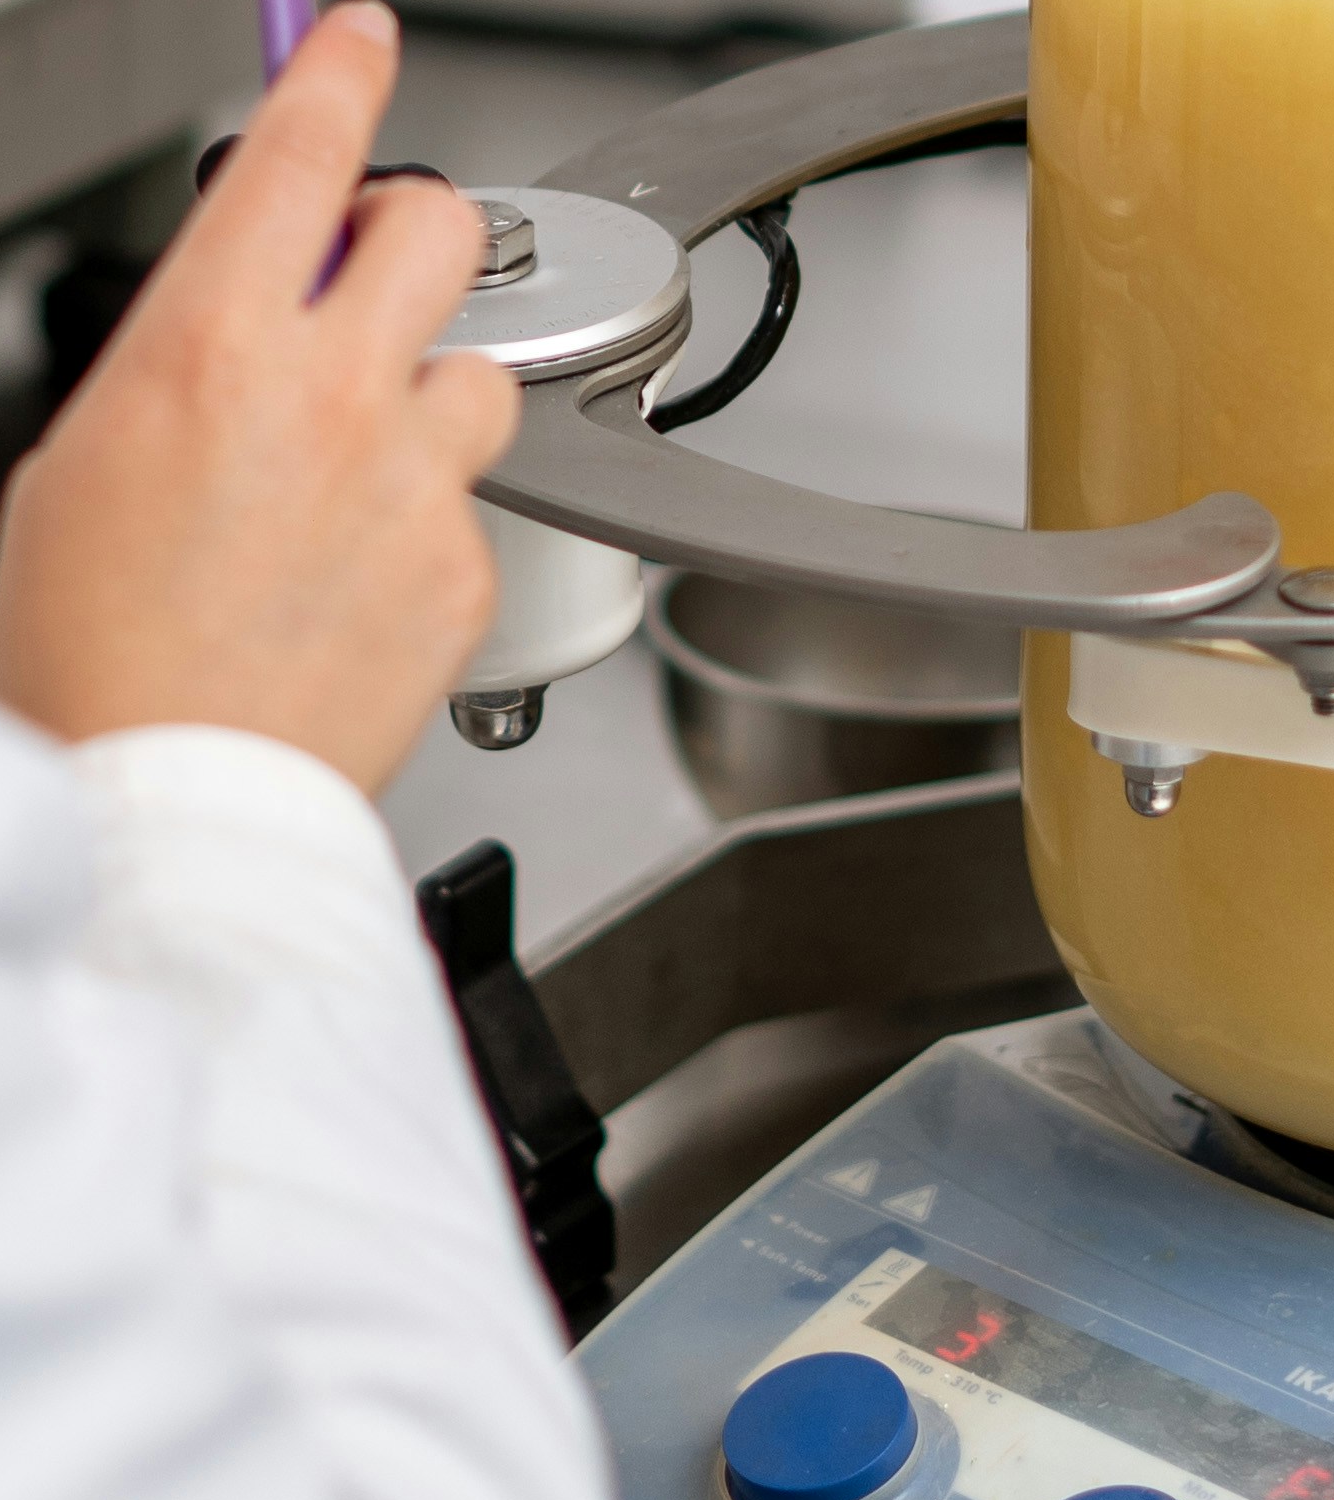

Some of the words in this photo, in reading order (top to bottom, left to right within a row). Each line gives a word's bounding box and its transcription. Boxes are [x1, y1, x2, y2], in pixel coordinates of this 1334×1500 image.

[786, 1220, 829, 1245] Power
[757, 1245, 788, 1264] Safe
[792, 1259, 828, 1283] Temp
[894, 1347, 935, 1376] Temp
